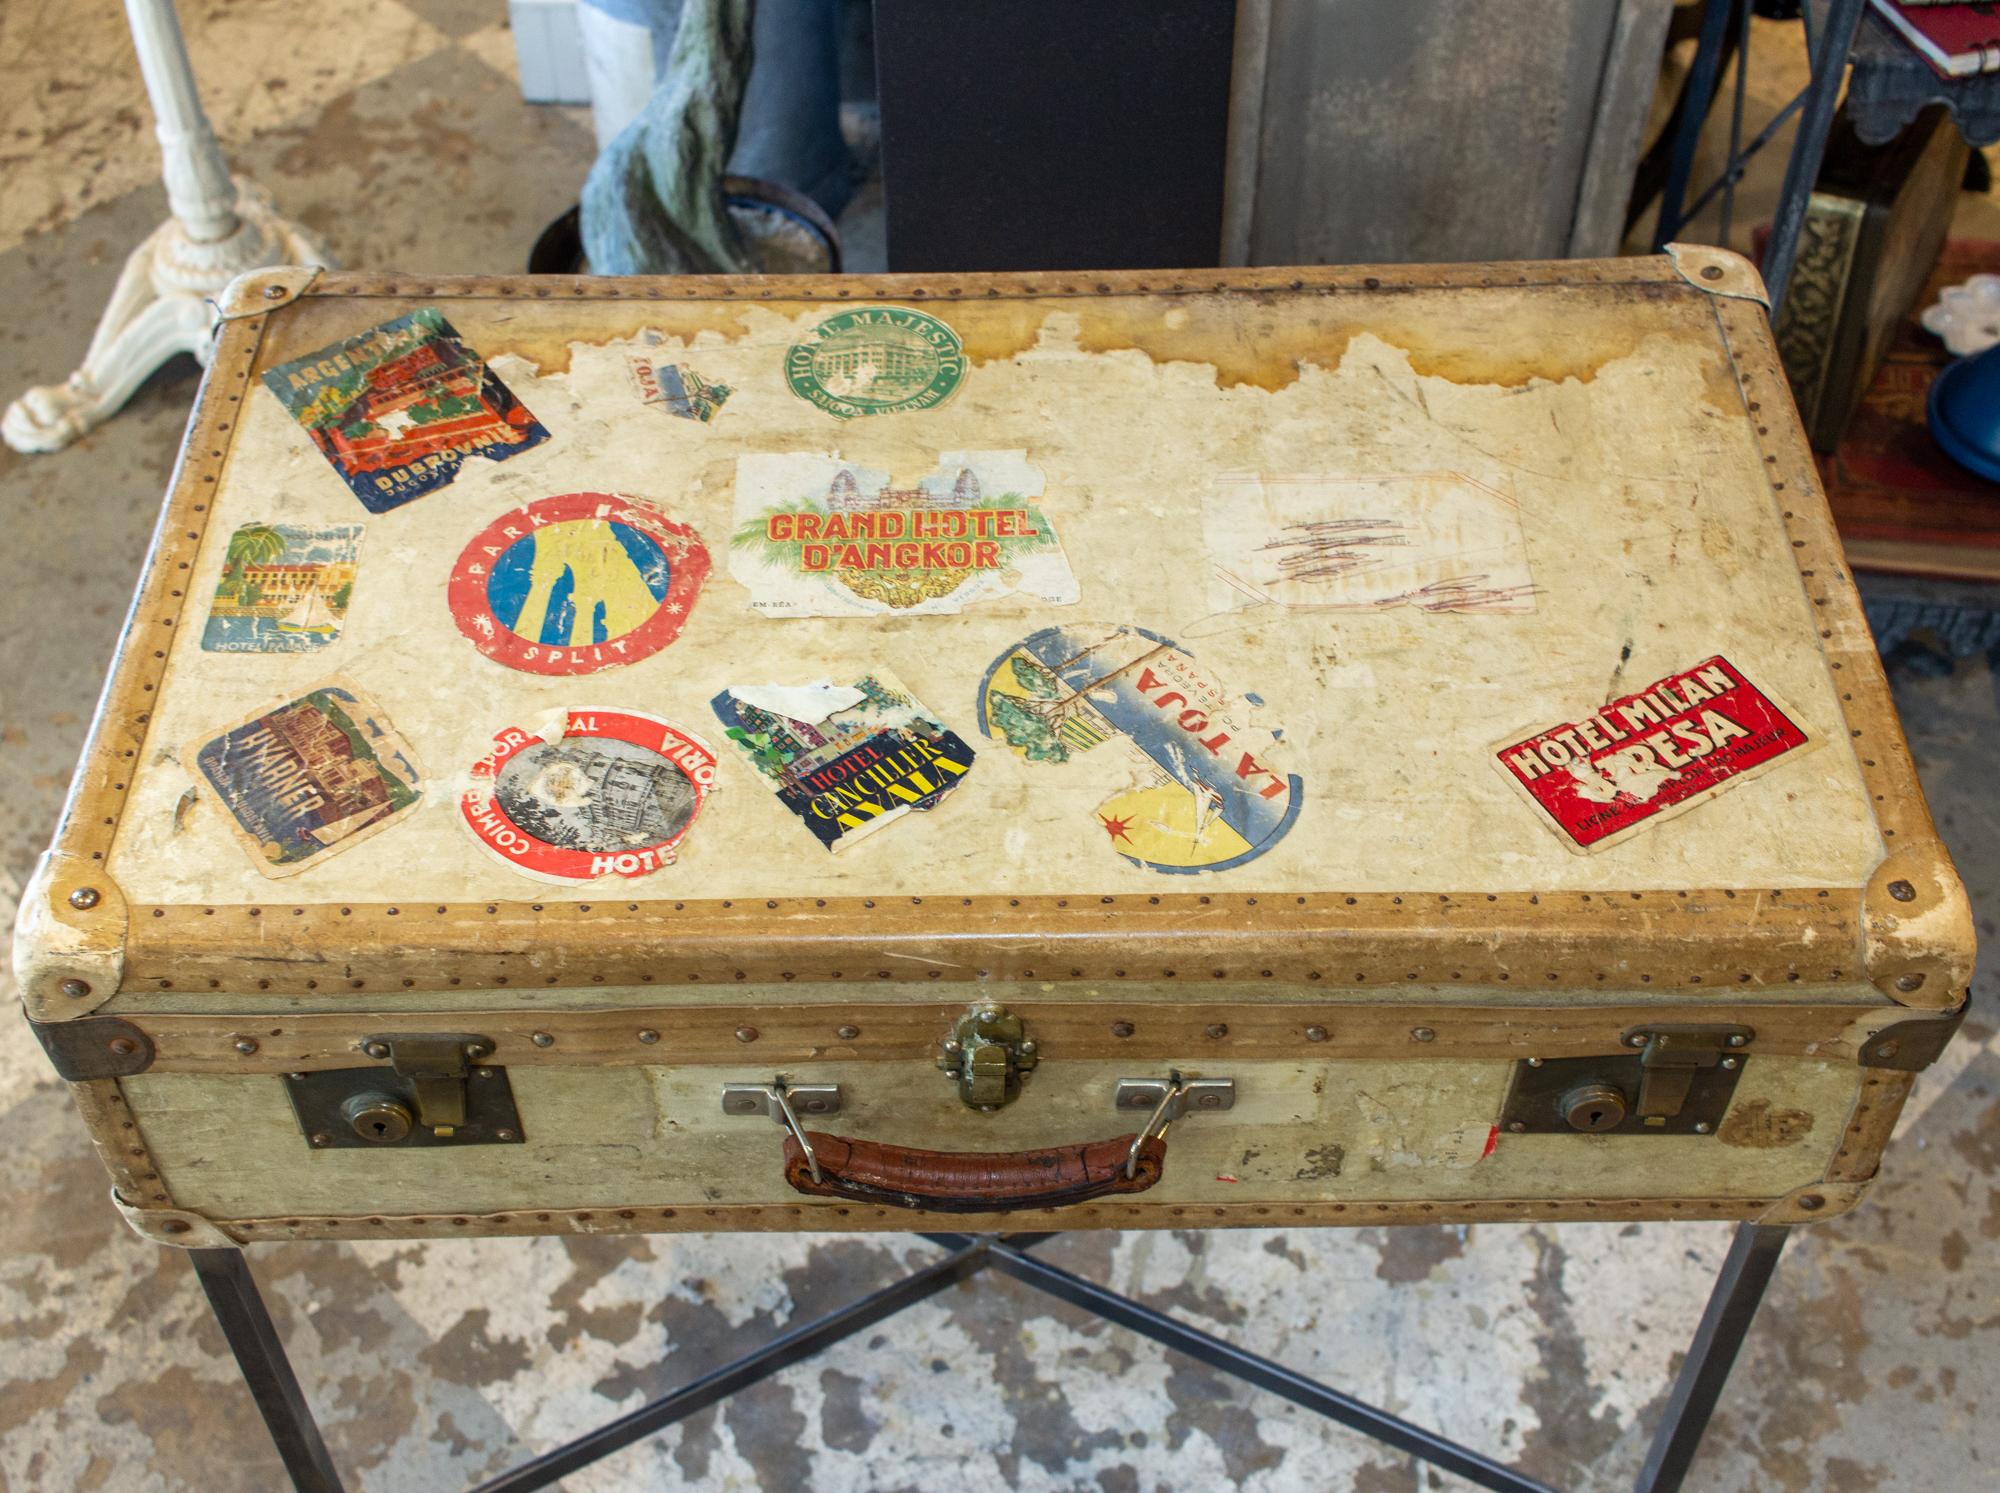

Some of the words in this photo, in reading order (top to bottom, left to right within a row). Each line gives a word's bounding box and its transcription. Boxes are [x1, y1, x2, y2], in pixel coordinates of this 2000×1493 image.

[851, 311, 960, 377] MAJESTIC
[375, 424, 518, 491] DUBROVNIK
[468, 513, 548, 575] PARK
[767, 511, 905, 542] GRAND
[912, 510, 1039, 538] HOTEL
[801, 541, 1002, 571] D'ANGKOR
[523, 640, 627, 664] SPLIT
[1135, 667, 1232, 757] TOJA
[1616, 664, 1739, 733] MILAN
[810, 746, 884, 790] HOTEL
[811, 738, 943, 820] CANCILLER
[836, 756, 969, 832] AYALA
[1235, 751, 1288, 801] LA
[590, 842, 679, 875] HOTE
